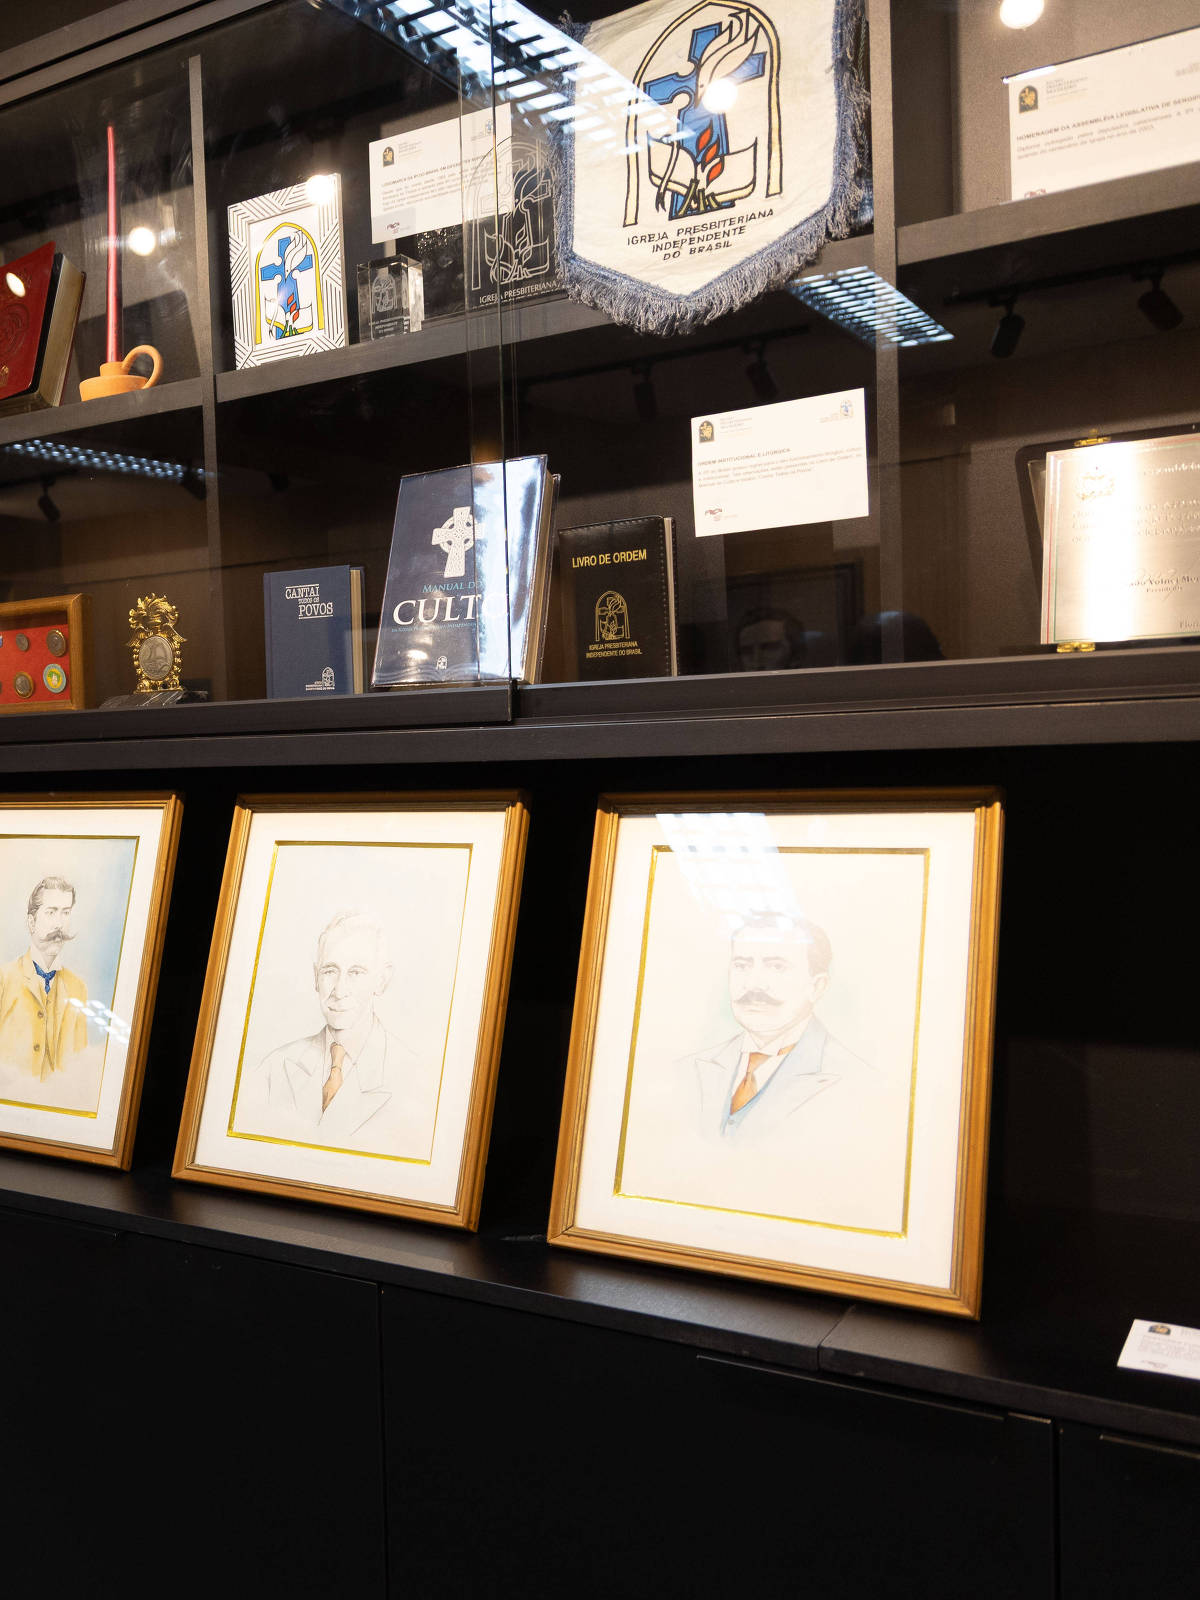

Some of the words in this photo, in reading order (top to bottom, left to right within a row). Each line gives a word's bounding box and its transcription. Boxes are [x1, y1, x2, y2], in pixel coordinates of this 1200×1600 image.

[627, 231, 669, 246] IGREJA
[676, 208, 775, 237] PRESBITERIANA
[652, 225, 747, 253] INDEPENDENTE
[663, 250, 681, 261] DO
[689, 240, 733, 255] BRASIL
[504, 280, 557, 299] PRESBITERIANA
[572, 555, 597, 568] LIVRO
[599, 553, 611, 565] DE
[613, 548, 647, 563] ORDEM
[285, 586, 320, 599] CANTAI
[422, 582, 465, 593] MANUAL
[298, 602, 334, 616] POVOS
